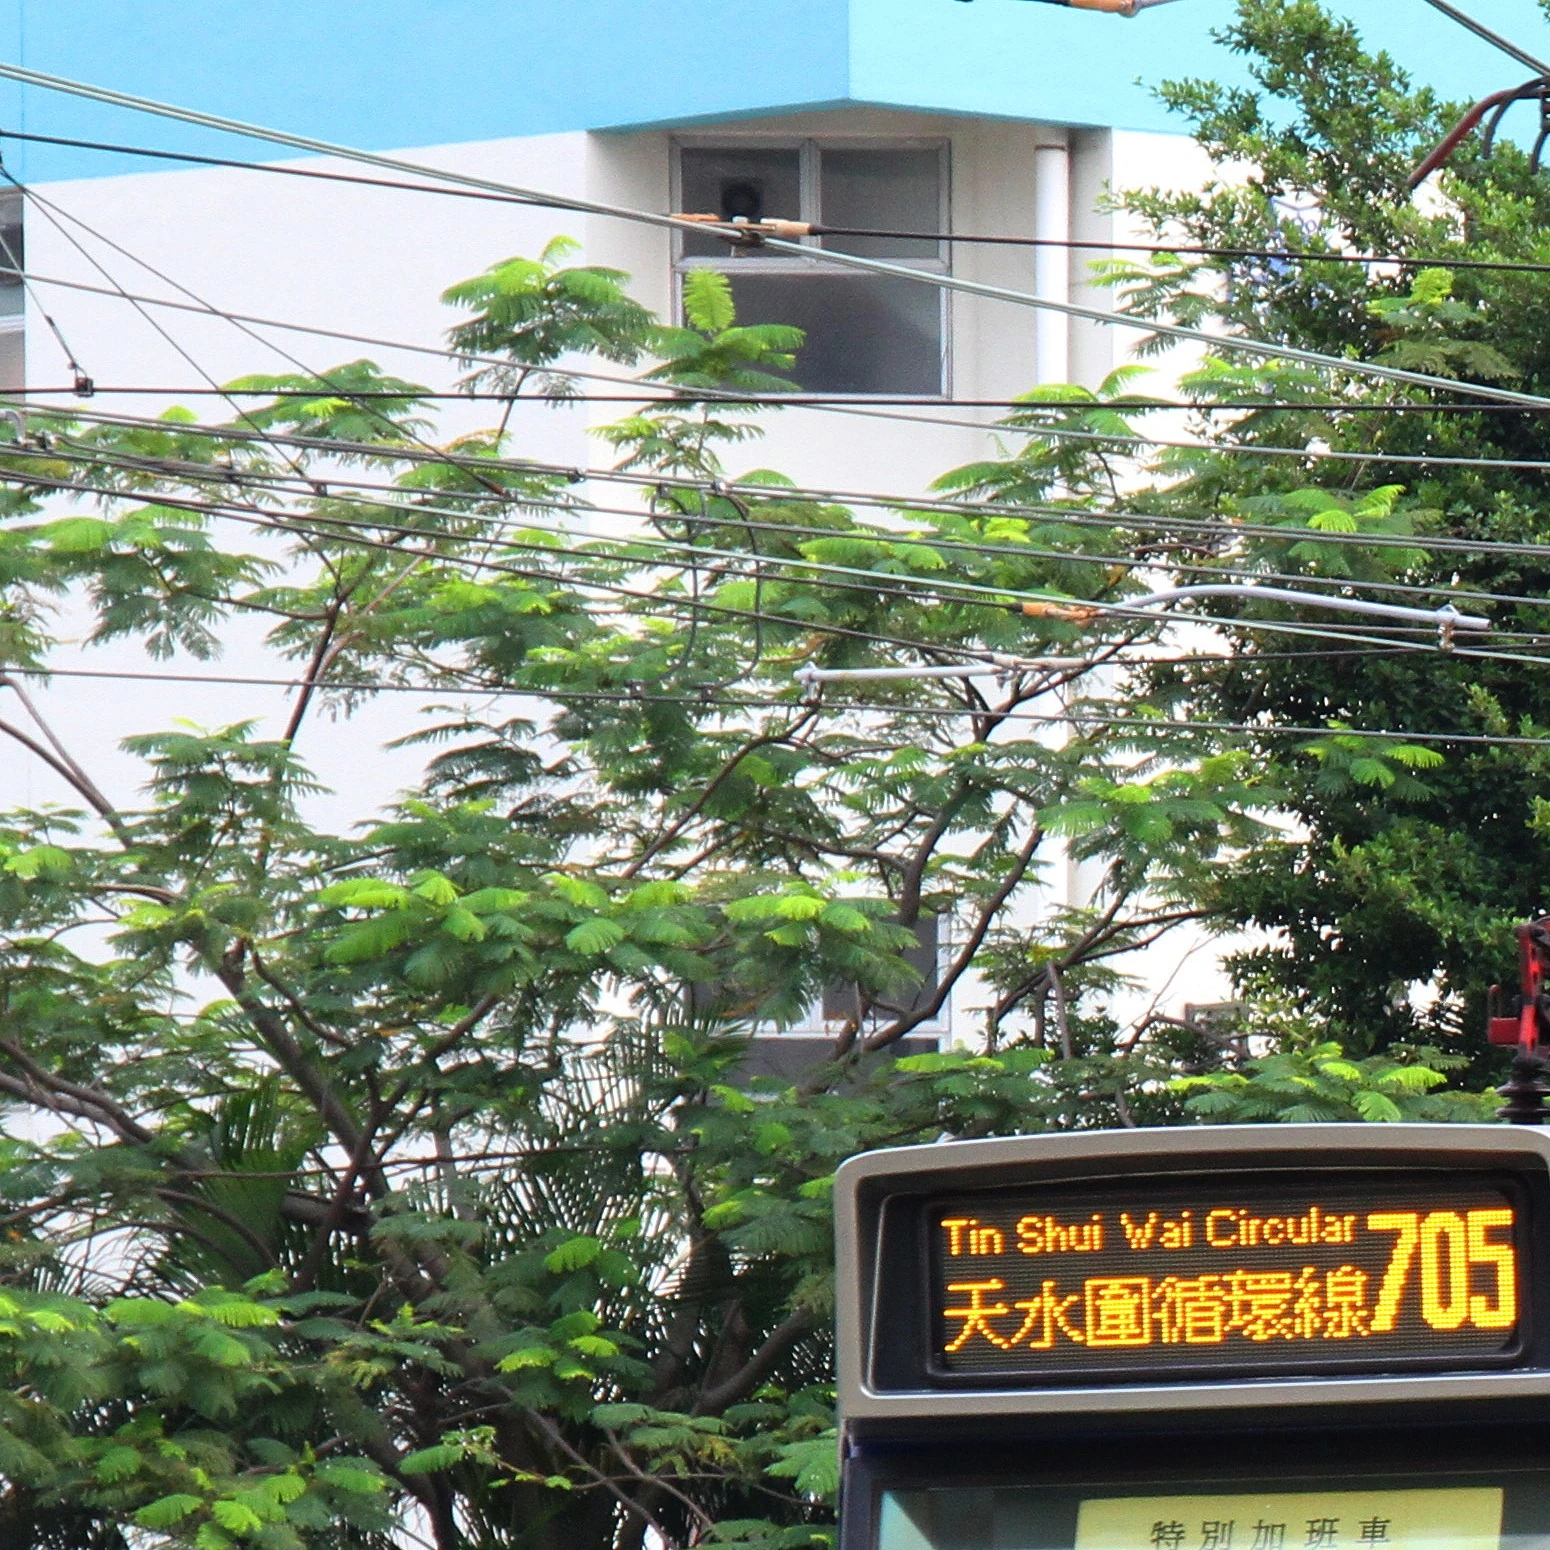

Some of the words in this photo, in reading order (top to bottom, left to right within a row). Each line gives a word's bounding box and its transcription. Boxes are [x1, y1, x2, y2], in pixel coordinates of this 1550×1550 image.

[940, 1218, 1004, 1257] Tin
[1015, 1213, 1103, 1253] Shui
[1119, 1208, 1192, 1250] Wai
[1205, 1206, 1357, 1248] Circular
[1366, 1207, 1517, 1333] 705
[942, 1264, 1370, 1353] 天水圍循環線
